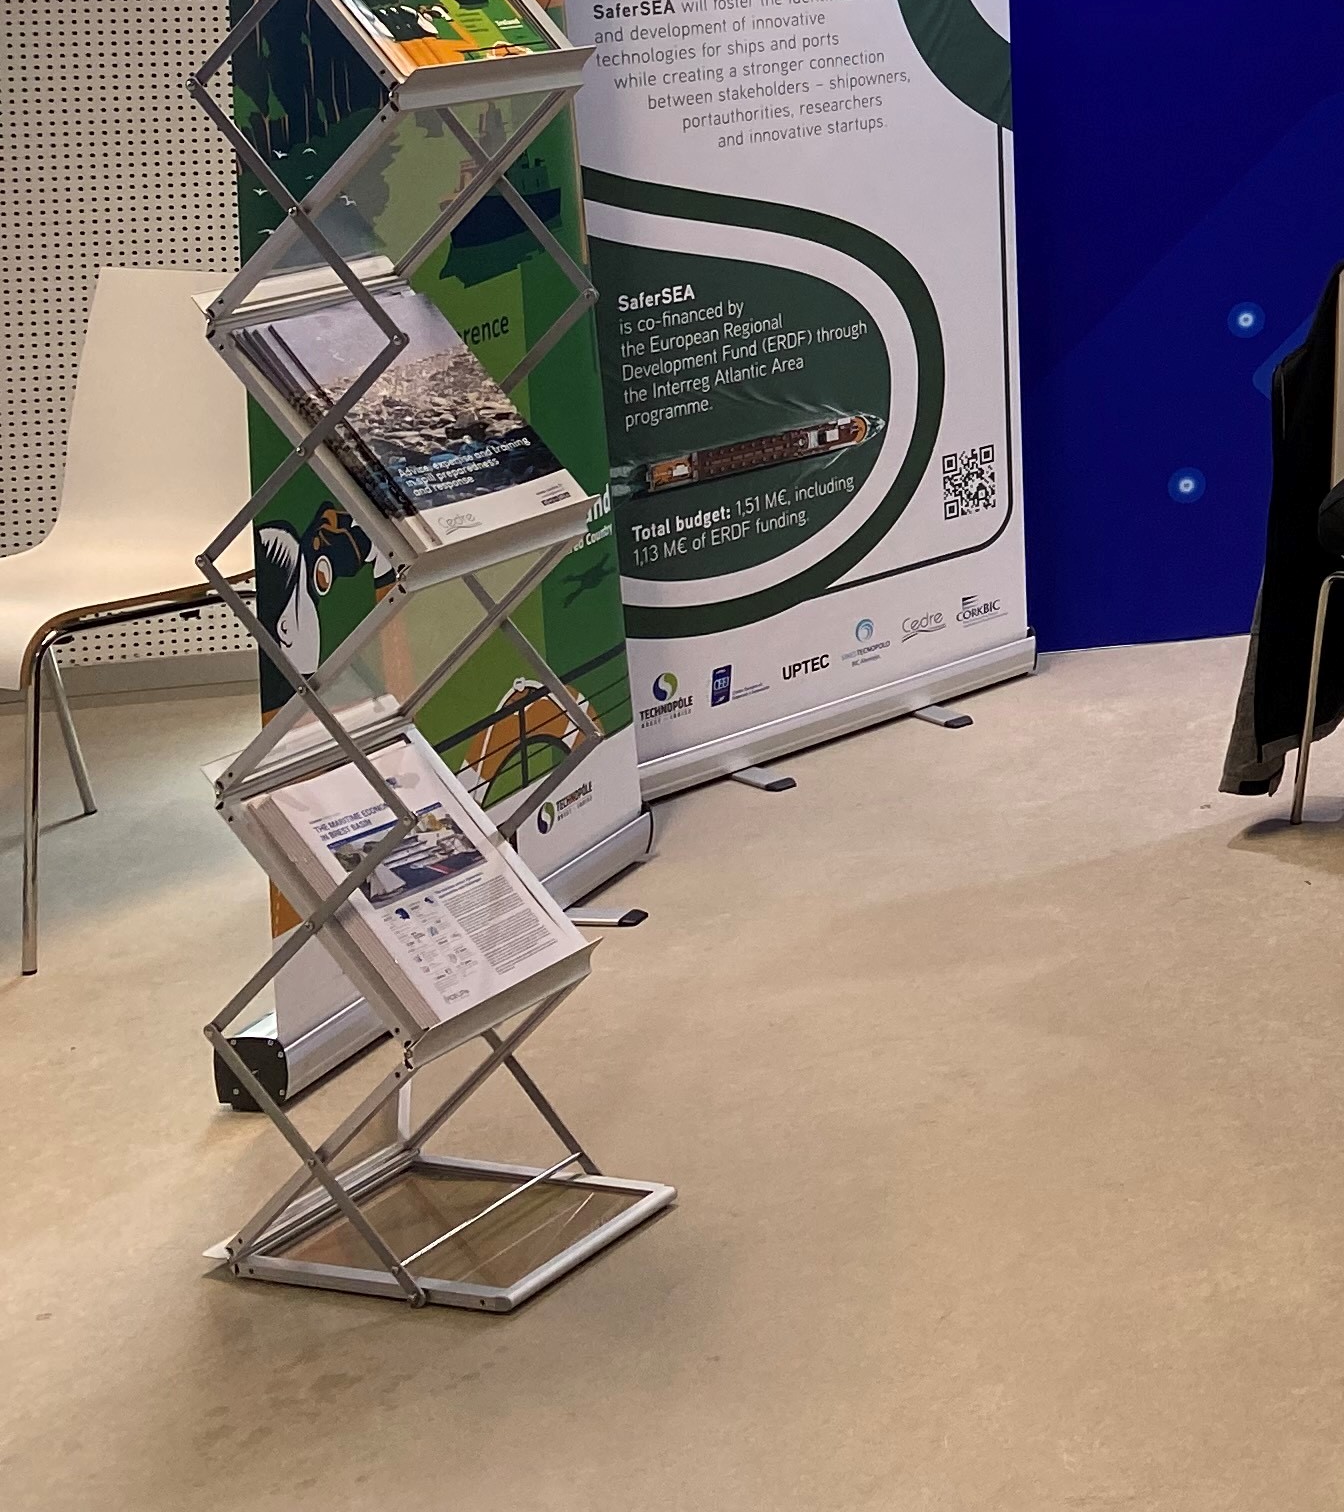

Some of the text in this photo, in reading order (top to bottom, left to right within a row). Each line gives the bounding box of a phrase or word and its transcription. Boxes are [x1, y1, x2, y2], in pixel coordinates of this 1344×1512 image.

[593, 0, 676, 19] SaferSEA
[595, 13, 825, 44] and development of innovative
[596, 32, 839, 67] technologies for ships and ports
[614, 52, 884, 89] while creating a stronger connection
[648, 71, 910, 110] between stakeholders shipowners,
[683, 95, 882, 133] portauthorities, researchers
[718, 116, 887, 148] and innovative startups.
[618, 284, 695, 311] SaferSEA
[619, 300, 744, 335] is co-financed by
[621, 313, 783, 358] the European Regional
[622, 320, 867, 381] Development Fund (ERDF) through
[624, 357, 804, 404] the Interreg Atlantic Area
[625, 399, 713, 432] programme.
[631, 518, 670, 542] Total
[676, 506, 731, 533] budget:
[795, 475, 855, 502] including
[633, 510, 809, 566] 1,13 M€ of ERDF funding.
[902, 612, 943, 633] Cedre
[956, 599, 1000, 622] CORKBIC
[782, 654, 830, 680] UPTEC
